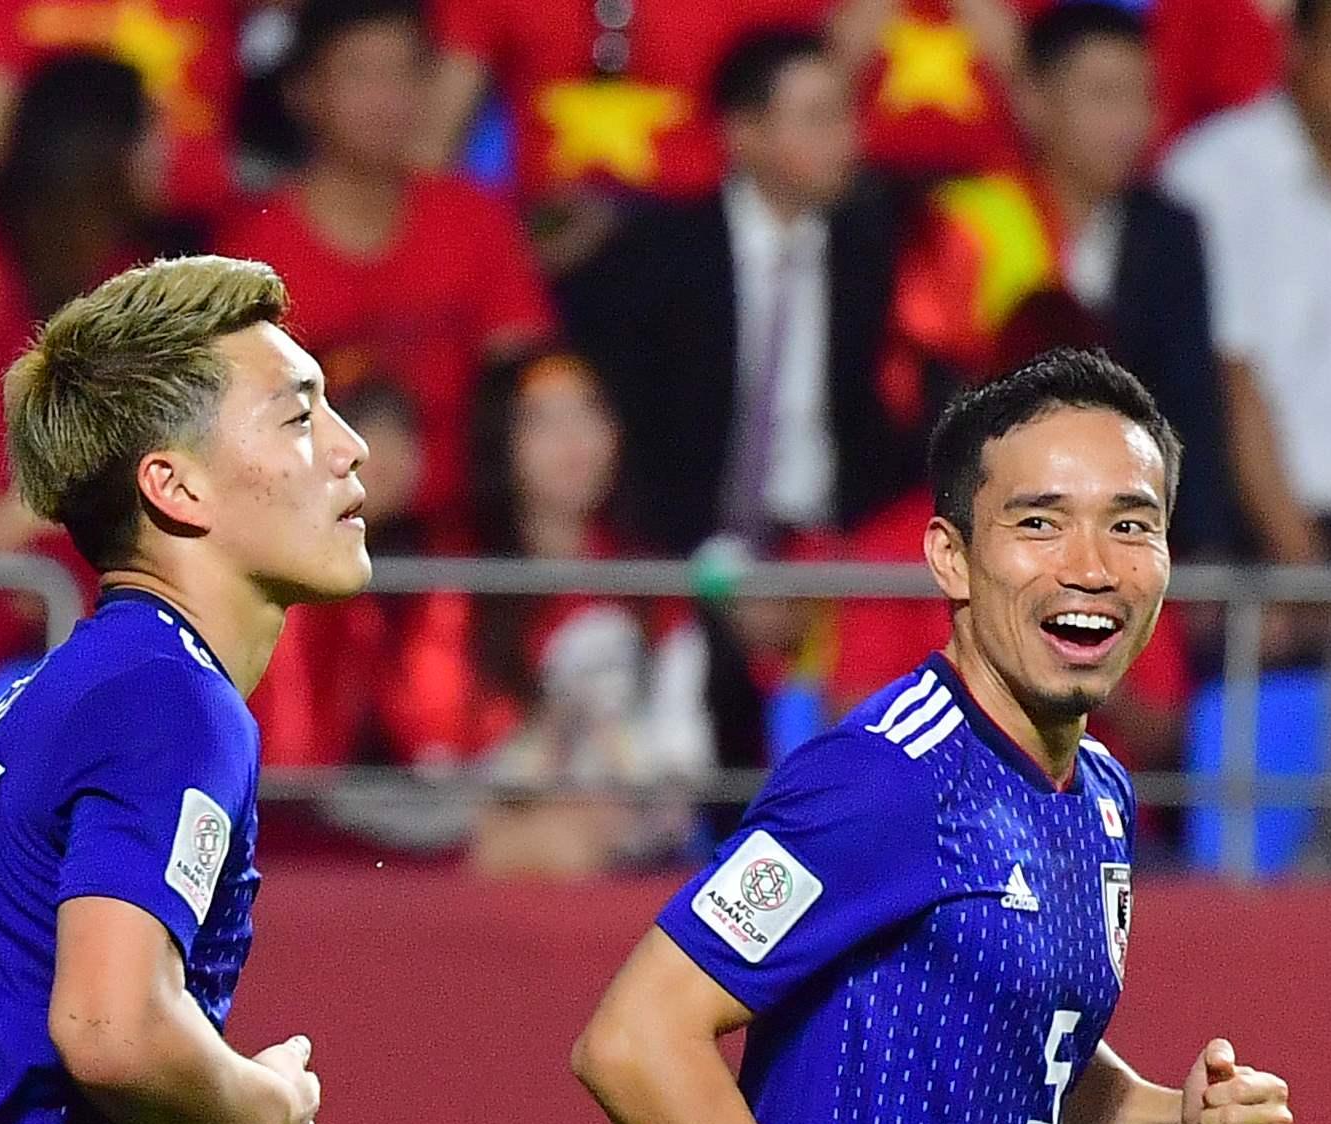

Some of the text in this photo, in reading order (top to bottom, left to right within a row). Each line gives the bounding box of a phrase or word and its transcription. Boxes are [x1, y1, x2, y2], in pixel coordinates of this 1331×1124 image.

[706, 890, 768, 944] ASIAN CUP
[733, 900, 755, 919] AFC
